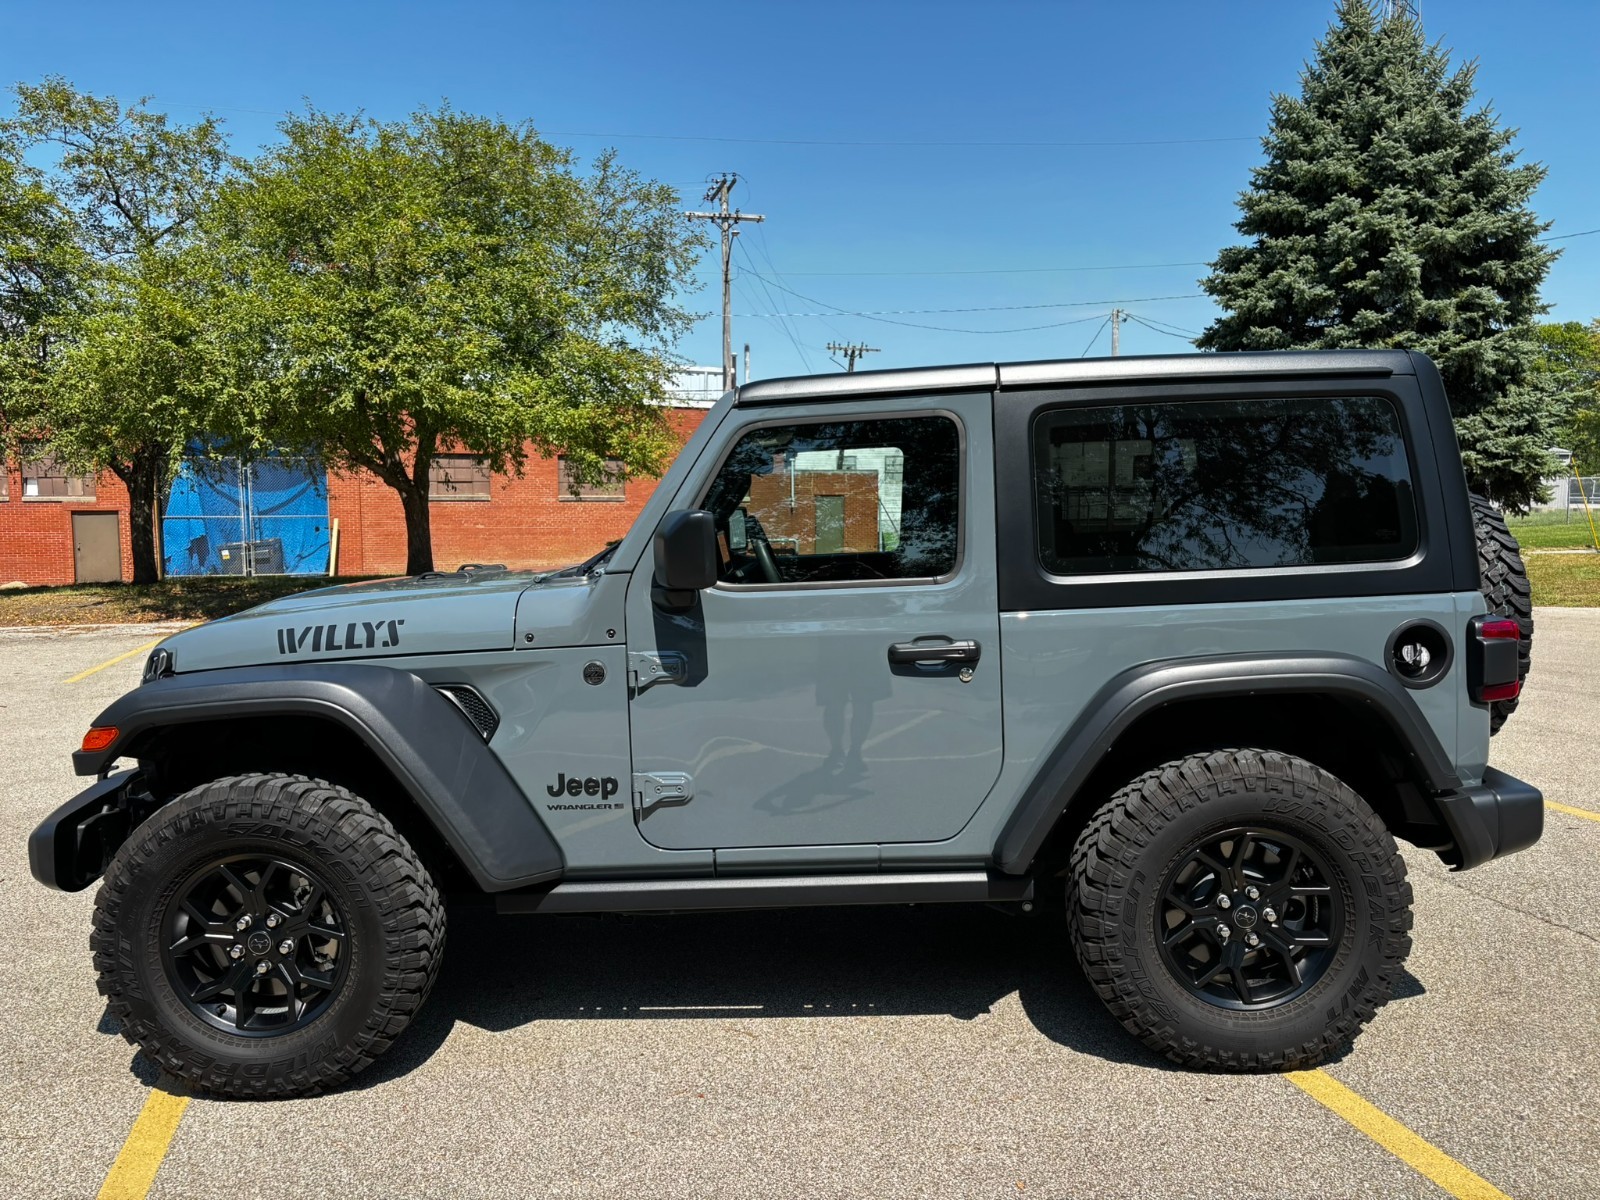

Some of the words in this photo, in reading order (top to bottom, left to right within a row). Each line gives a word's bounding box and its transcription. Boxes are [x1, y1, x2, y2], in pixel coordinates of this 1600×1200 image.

[277, 619, 405, 655] WILLYS
[546, 772, 618, 800] Jeep
[546, 803, 612, 811] WRANGLER
[1262, 797, 1385, 953] WILDPEAK
[1325, 965, 1370, 1028] M/T
[142, 1019, 338, 1077] WILDPEAK
